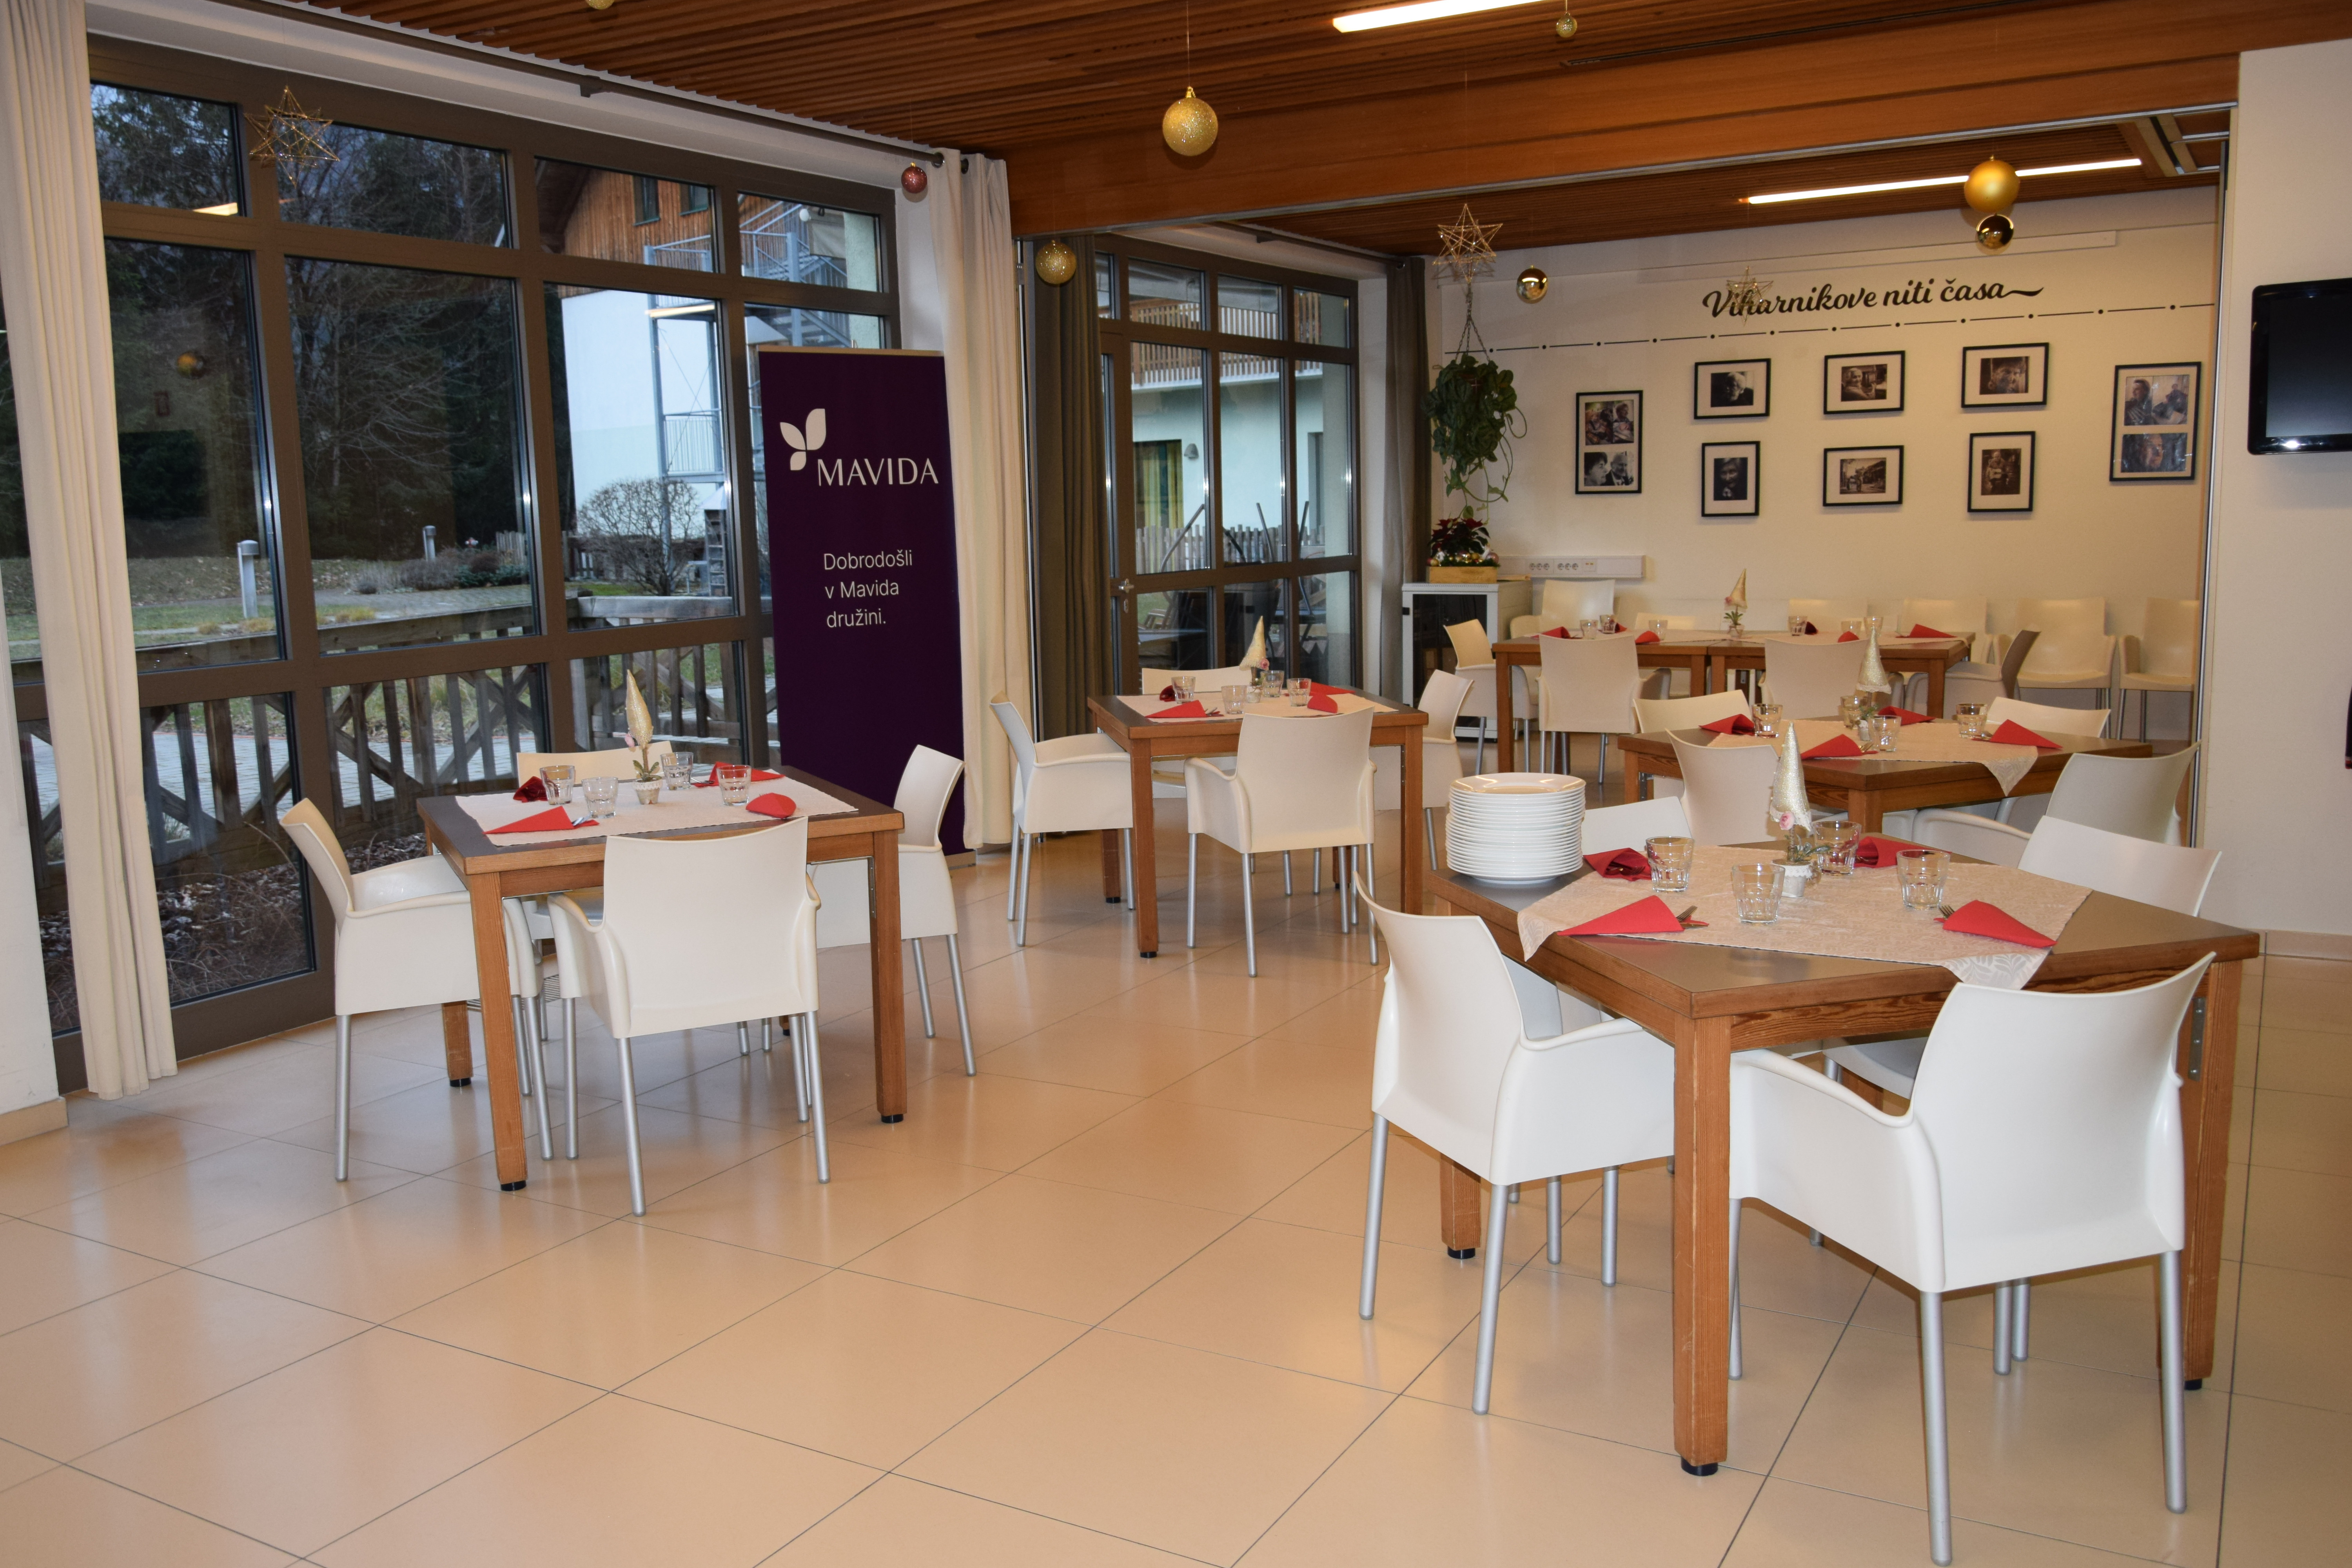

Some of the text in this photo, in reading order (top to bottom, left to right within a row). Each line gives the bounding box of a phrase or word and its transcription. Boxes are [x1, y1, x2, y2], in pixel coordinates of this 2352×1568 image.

[1702, 278, 2044, 318] Viharnikove niti časa
[818, 457, 939, 486] MAVIDA
[823, 549, 913, 570] Dobrodošli
[825, 579, 899, 599] v Mavida
[826, 608, 887, 628] družini.
